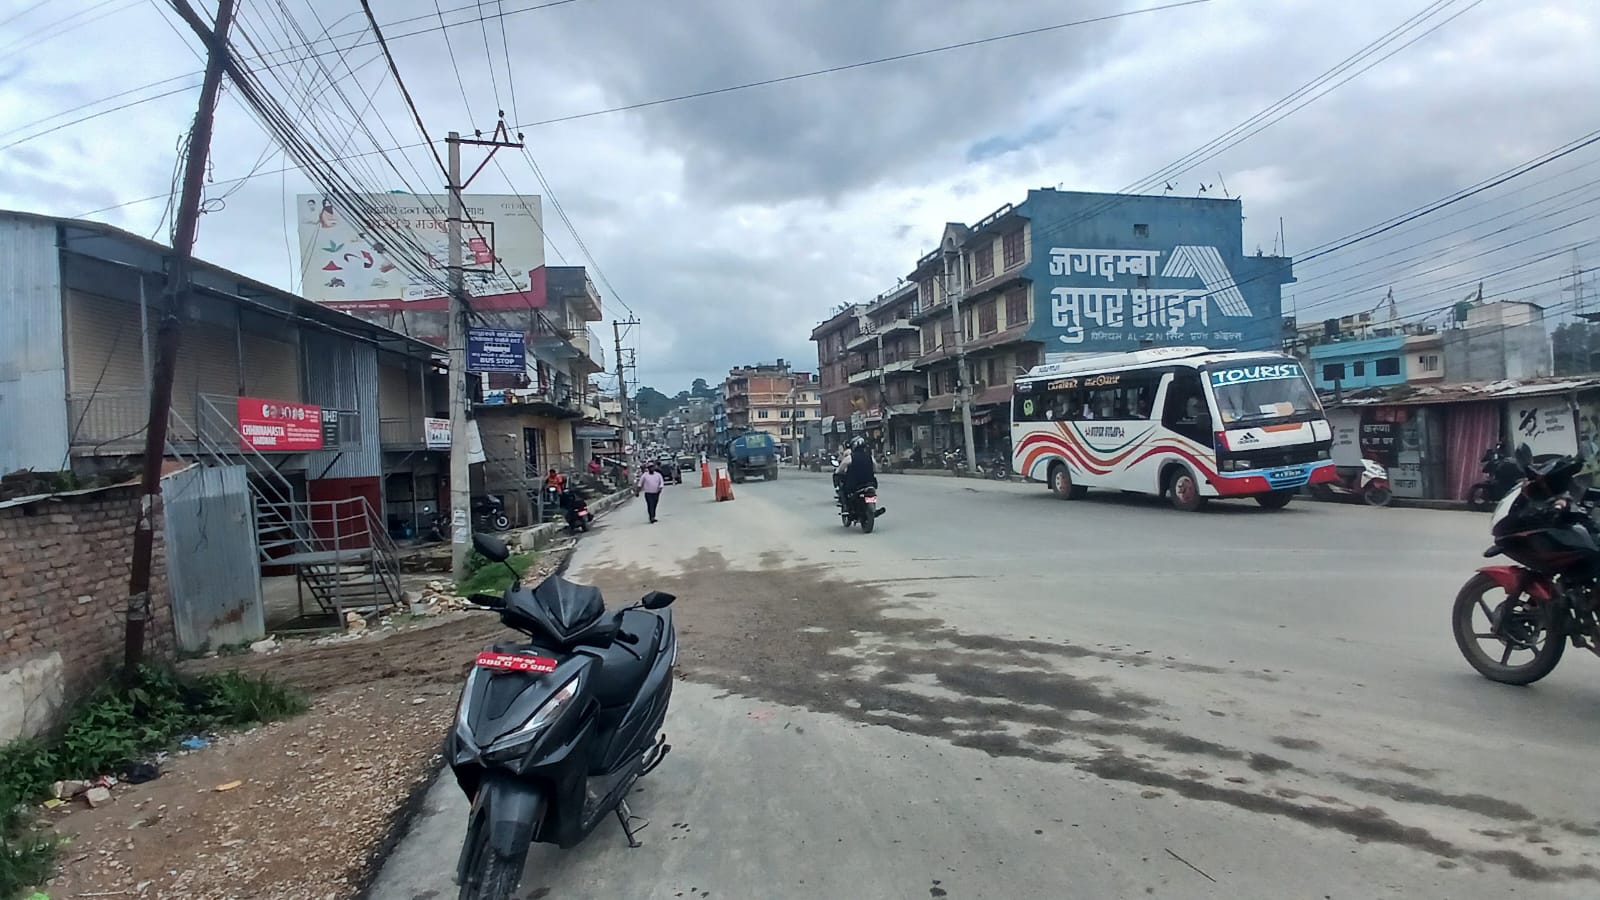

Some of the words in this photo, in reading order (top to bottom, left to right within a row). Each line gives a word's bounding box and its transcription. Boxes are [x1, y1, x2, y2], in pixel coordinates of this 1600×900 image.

[1049, 247, 1161, 282] जगदम्बा
[1050, 287, 1128, 343] सुपर
[1130, 288, 1209, 333] शाइन
[1212, 364, 1299, 383] TOURIST
